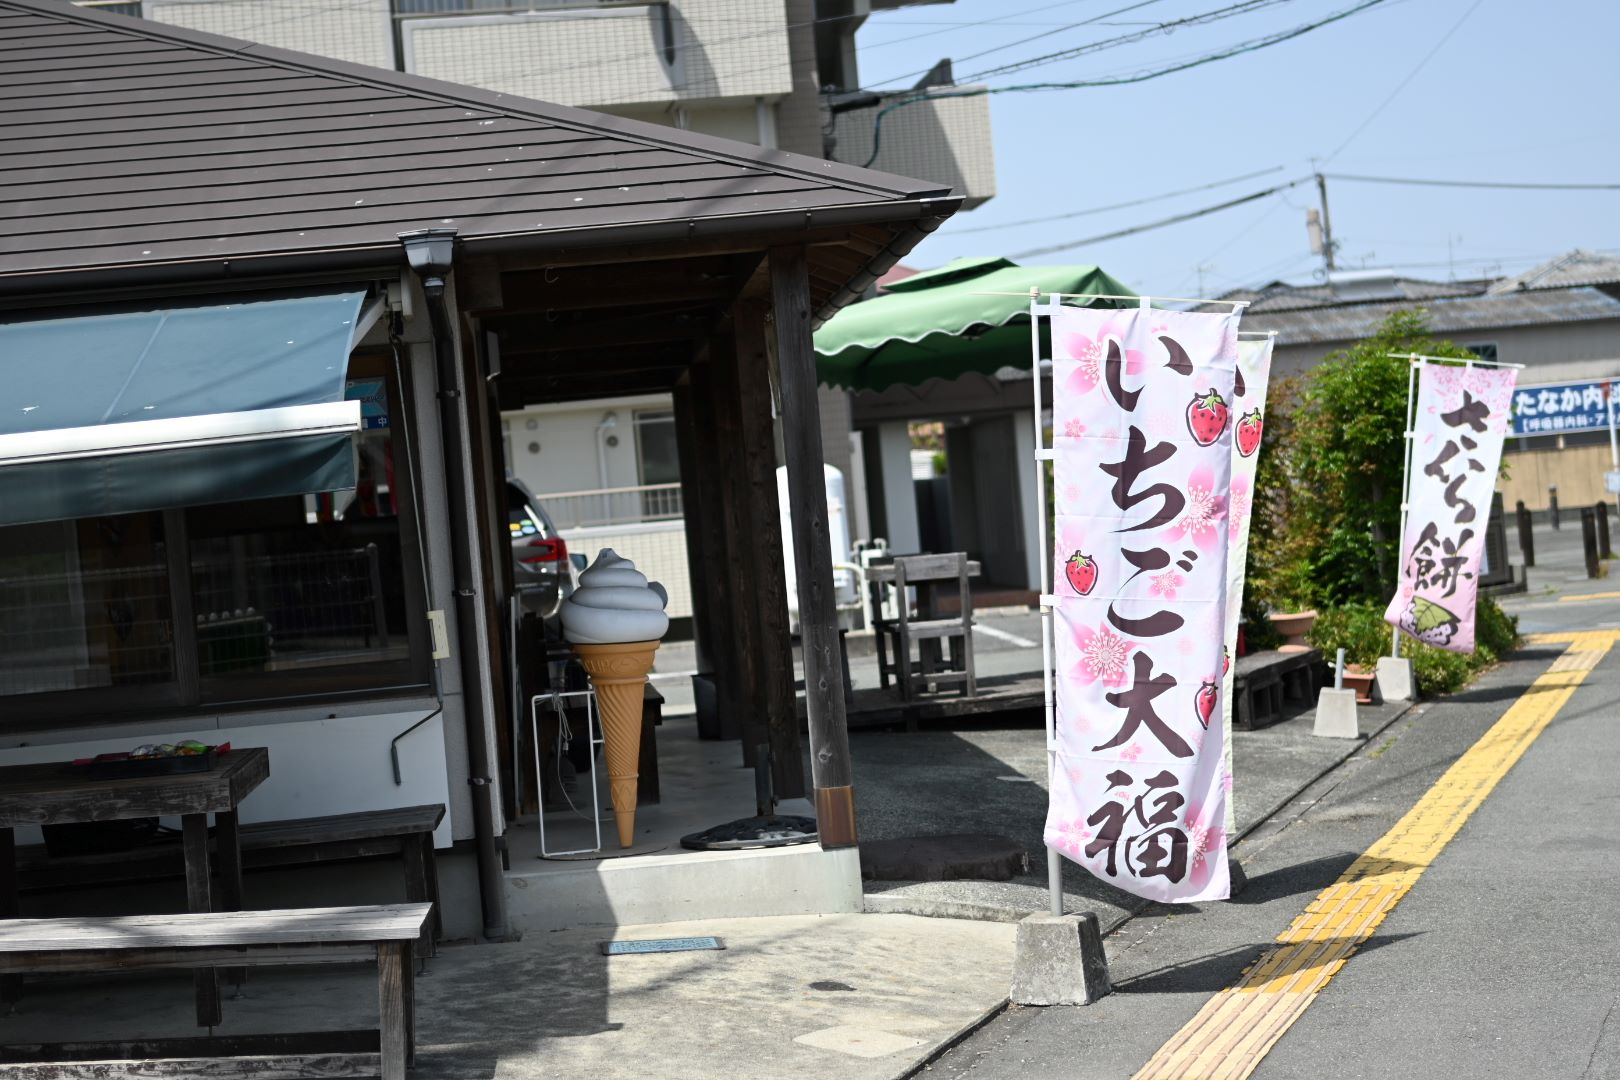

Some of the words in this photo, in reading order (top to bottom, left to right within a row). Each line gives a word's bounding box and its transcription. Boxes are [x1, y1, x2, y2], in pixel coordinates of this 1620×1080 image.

[1086, 334, 1198, 884] いちご大福
[1406, 390, 1490, 598] さくら餅
